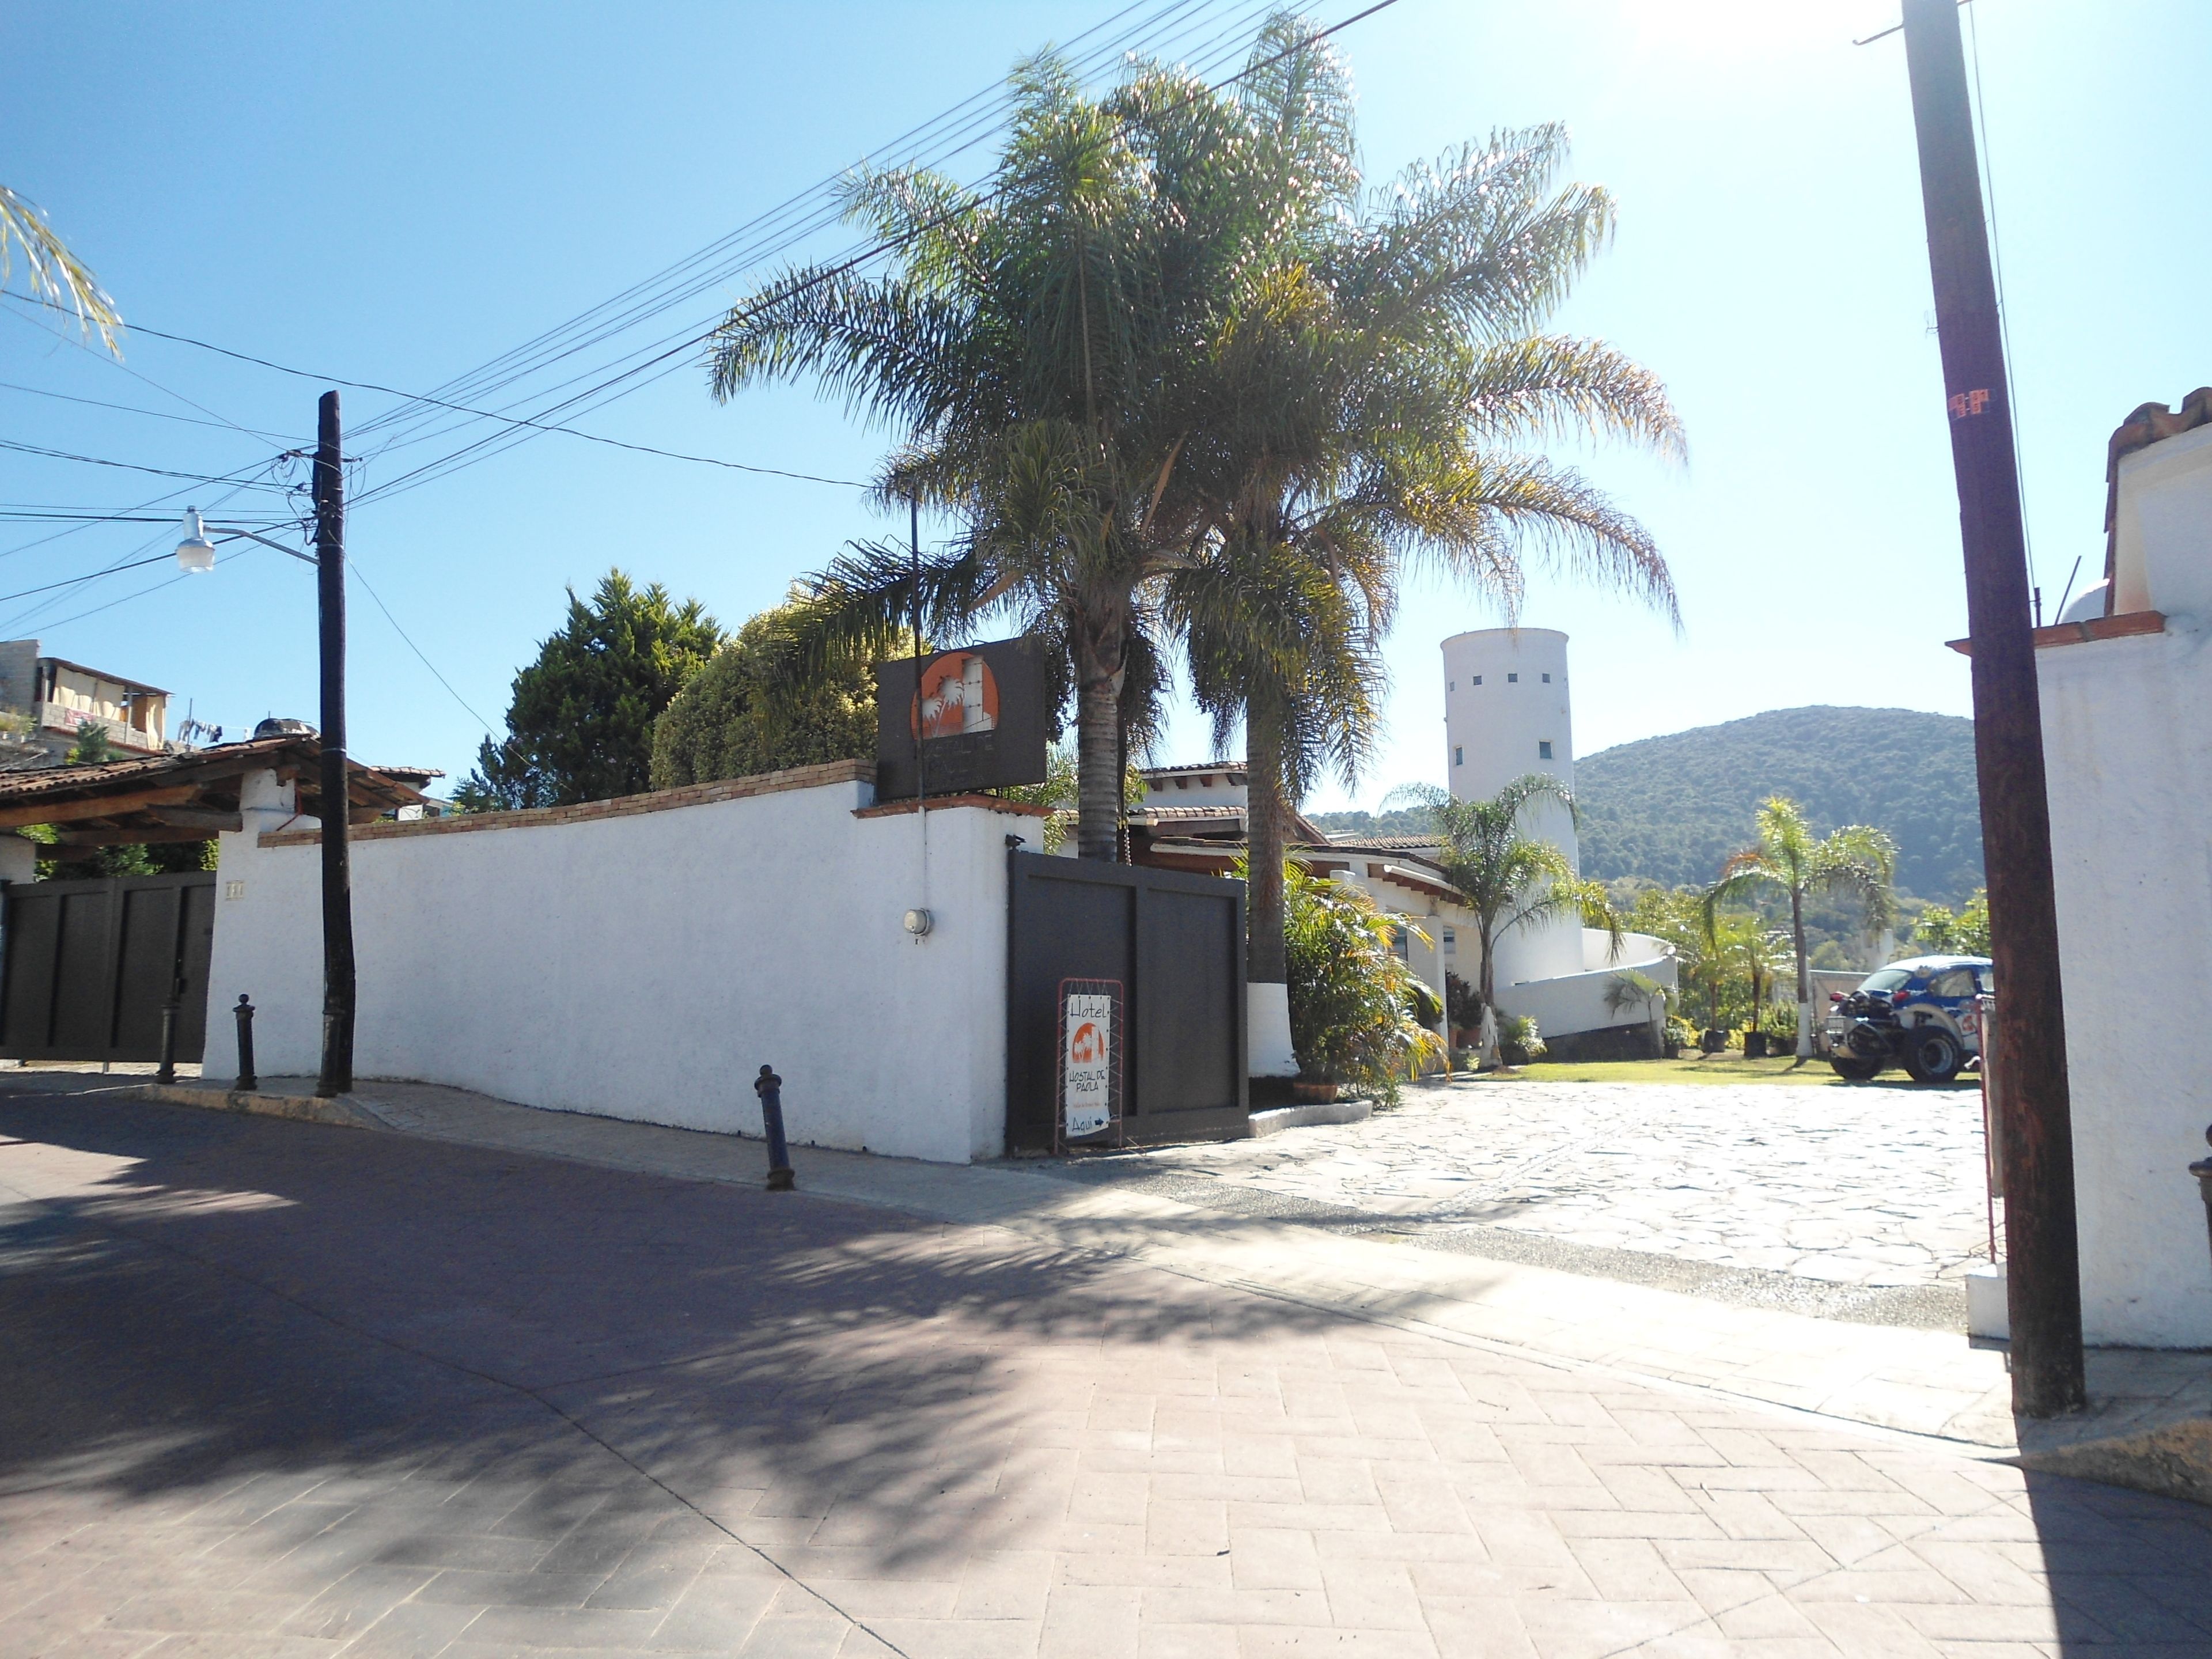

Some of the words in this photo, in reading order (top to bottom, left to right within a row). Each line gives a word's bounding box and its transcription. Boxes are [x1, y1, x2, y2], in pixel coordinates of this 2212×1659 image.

[915, 738, 972, 760] OSTAL
[1070, 999, 1107, 1018] Hotel
[1069, 1071, 1095, 1082] HOSTAL
[1097, 1070, 1105, 1080] DE
[1076, 1081, 1099, 1092] PAOLA
